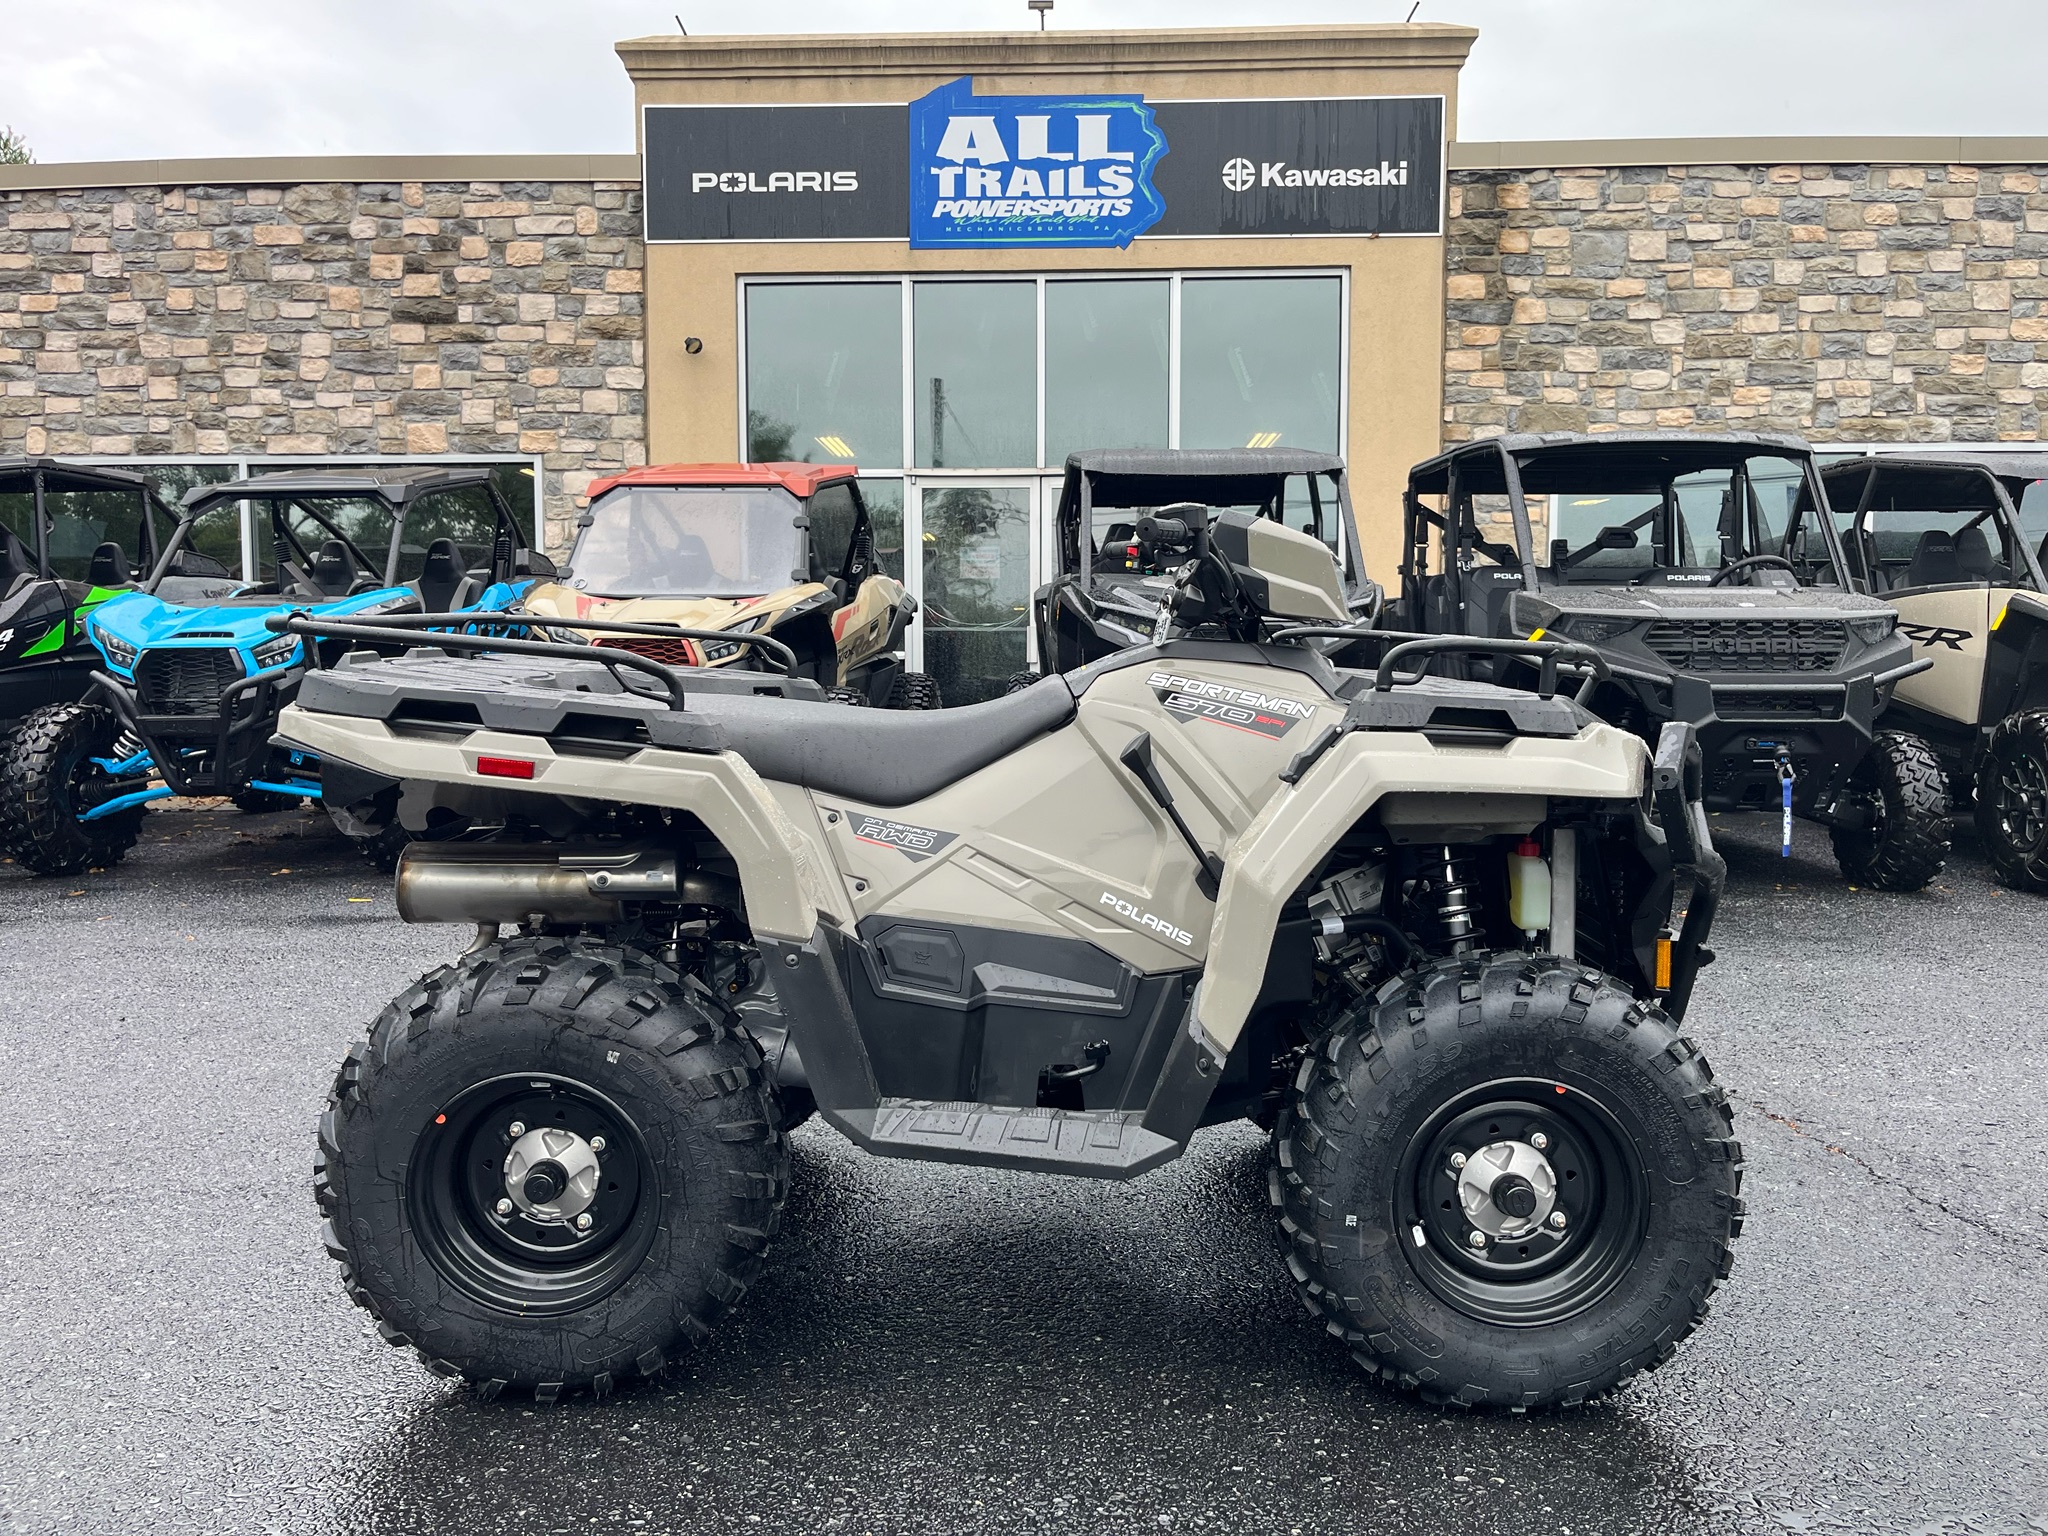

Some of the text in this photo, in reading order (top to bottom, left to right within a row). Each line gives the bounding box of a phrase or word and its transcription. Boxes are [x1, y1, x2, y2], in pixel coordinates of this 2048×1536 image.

[936, 114, 1134, 166] ALL
[692, 171, 859, 193] POLARIS
[930, 165, 1135, 198] TRAILS
[1261, 161, 1408, 187] Kawasaki
[932, 199, 1133, 218] POWERSPORTS
[1493, 572, 1523, 580] POLA
[1666, 574, 1712, 582] POLARIS
[1692, 637, 1818, 654] POLARIS
[1145, 671, 1319, 720] SPORTSMAN
[1164, 693, 1256, 724] 570
[857, 822, 934, 849] AWD
[864, 817, 938, 838] ON DEMAND
[1783, 806, 1792, 846] POLARIS
[1099, 891, 1194, 946] POLARIS
[1575, 1254, 1693, 1374] CARLSTAR
